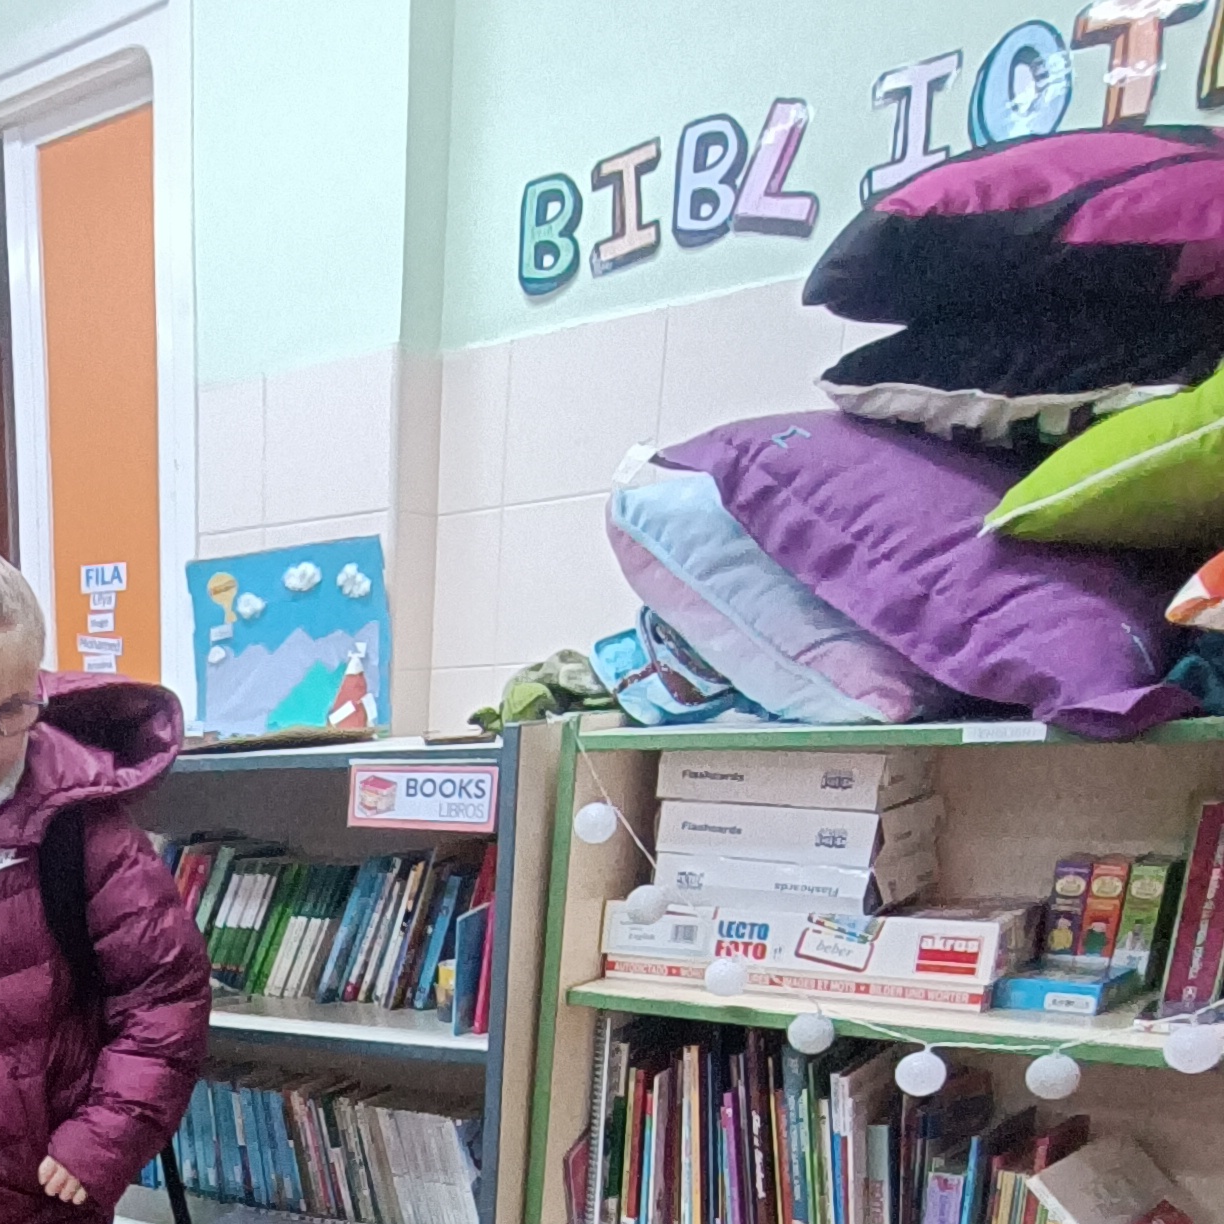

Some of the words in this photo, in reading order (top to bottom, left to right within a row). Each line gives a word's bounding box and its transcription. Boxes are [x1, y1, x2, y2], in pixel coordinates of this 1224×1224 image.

[85, 565, 123, 587] FILA
[682, 769, 744, 782] Flashcards
[405, 777, 487, 799] BOOKS
[438, 801, 484, 819] LIBROS
[681, 820, 742, 835] Flashcards
[774, 881, 839, 898] Flashcards
[718, 920, 770, 941] LECTO
